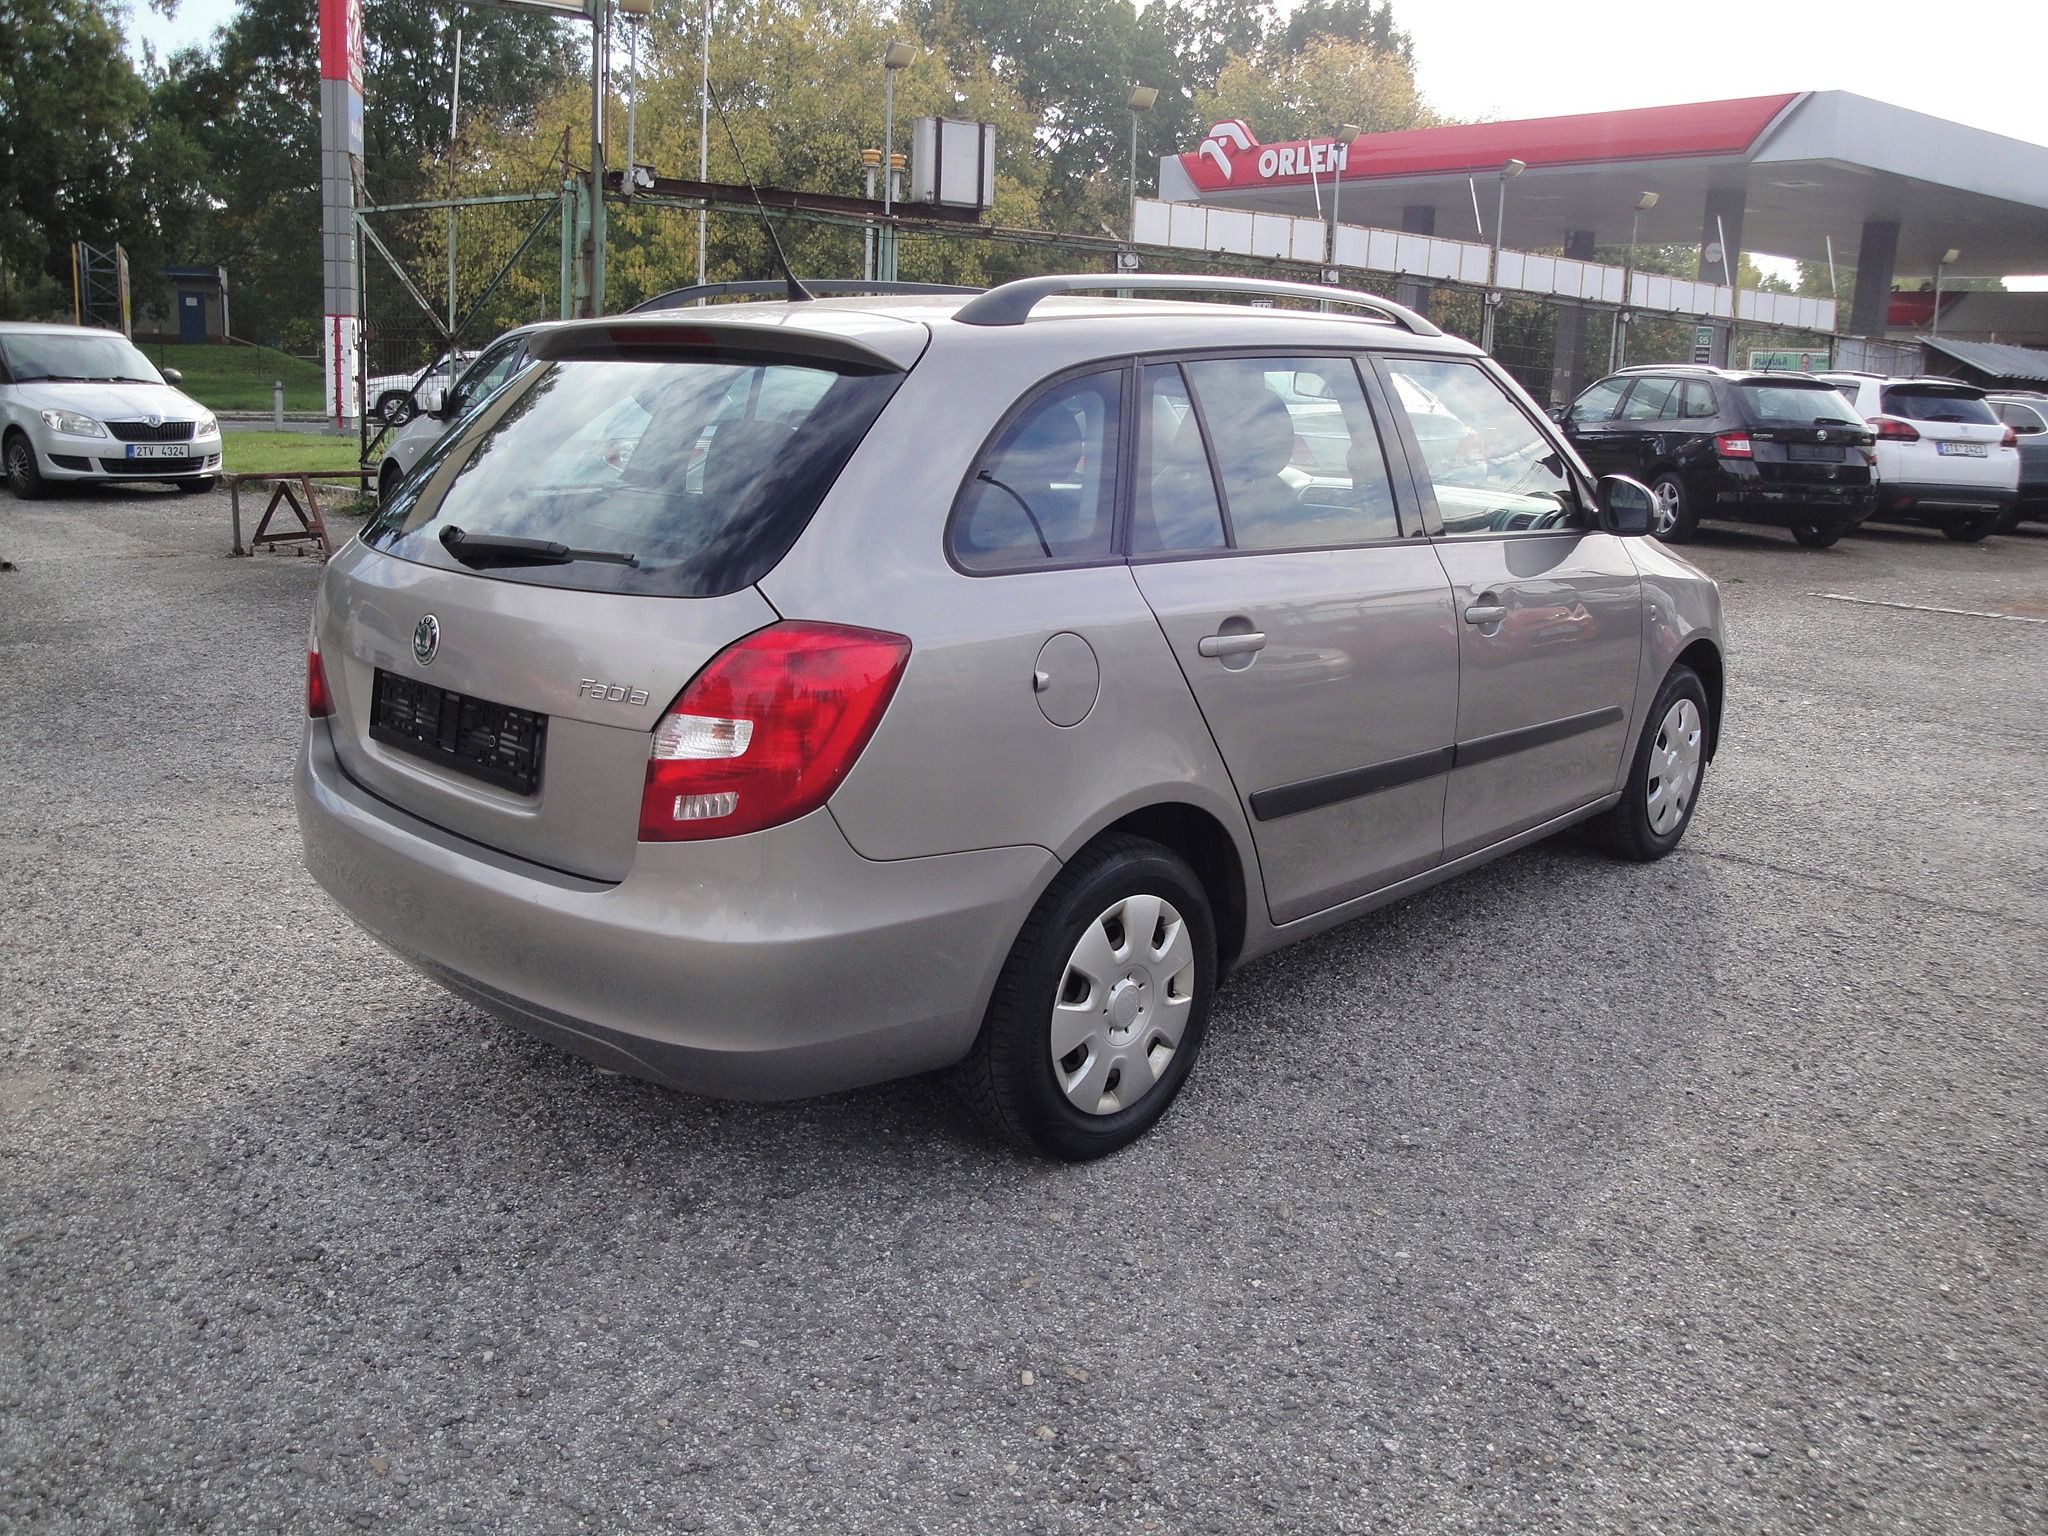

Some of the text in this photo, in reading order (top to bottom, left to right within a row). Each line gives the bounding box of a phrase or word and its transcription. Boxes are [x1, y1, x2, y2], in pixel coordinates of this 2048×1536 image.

[1258, 143, 1348, 178] ORLEN
[1698, 336, 1709, 344] 95
[136, 446, 184, 456] 2TV 4324
[579, 678, 649, 706] Fabia
